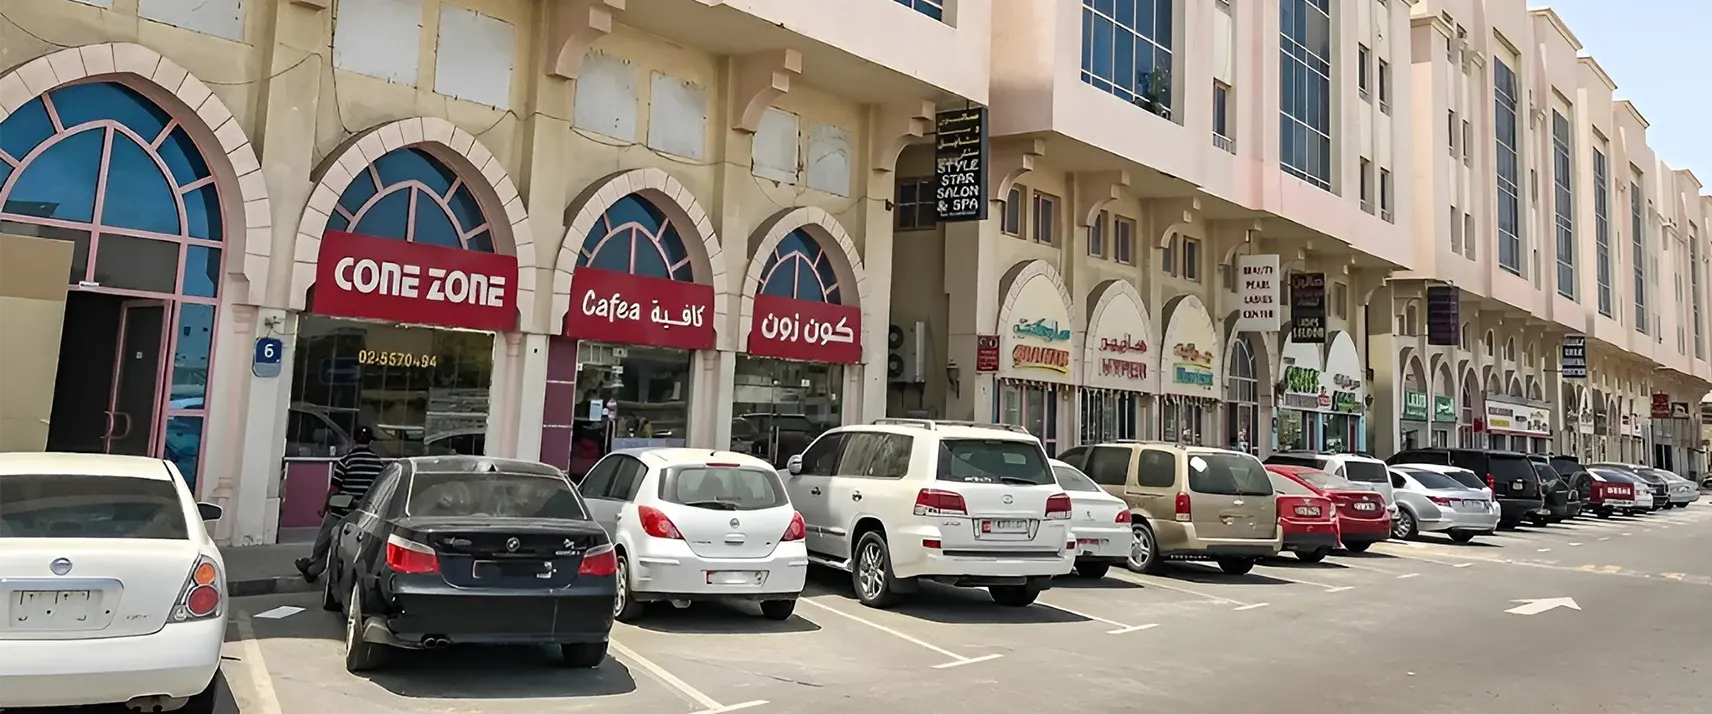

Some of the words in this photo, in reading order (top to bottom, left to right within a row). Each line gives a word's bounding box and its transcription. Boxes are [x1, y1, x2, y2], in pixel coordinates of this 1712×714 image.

[937, 159, 979, 173] STYLE
[941, 172, 975, 187] STAR
[936, 185, 979, 199] SALON
[936, 200, 948, 212] &
[952, 198, 979, 211] SPA
[334, 256, 420, 298] CONE
[425, 267, 506, 307] ZONE
[582, 289, 640, 323] Cafea
[761, 312, 799, 343] زون
[804, 316, 853, 345] كون
[264, 343, 274, 358] 6
